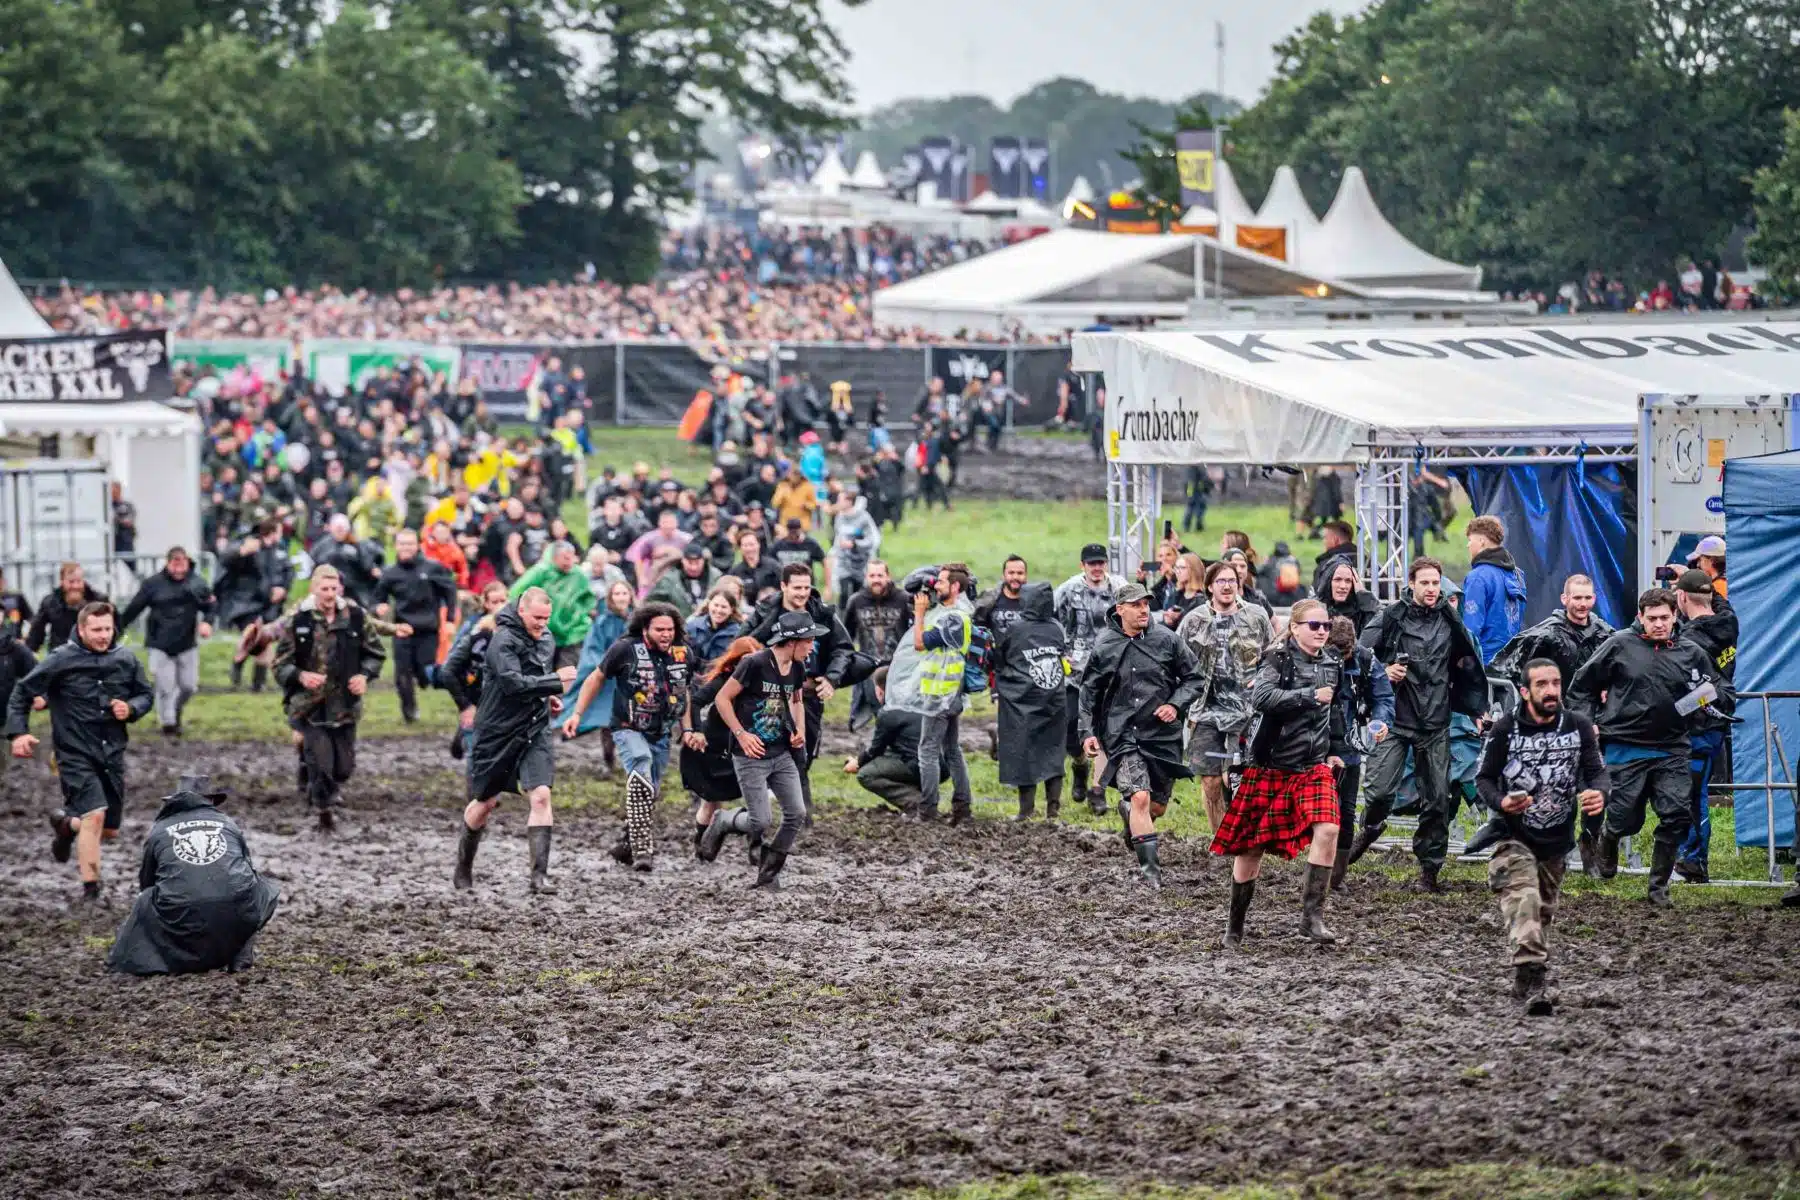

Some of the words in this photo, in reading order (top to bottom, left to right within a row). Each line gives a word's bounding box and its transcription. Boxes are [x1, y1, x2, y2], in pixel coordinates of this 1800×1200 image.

[57, 367, 123, 399] XXL
[1022, 646, 1062, 662] WACKE
[166, 819, 225, 837] WACKEN
